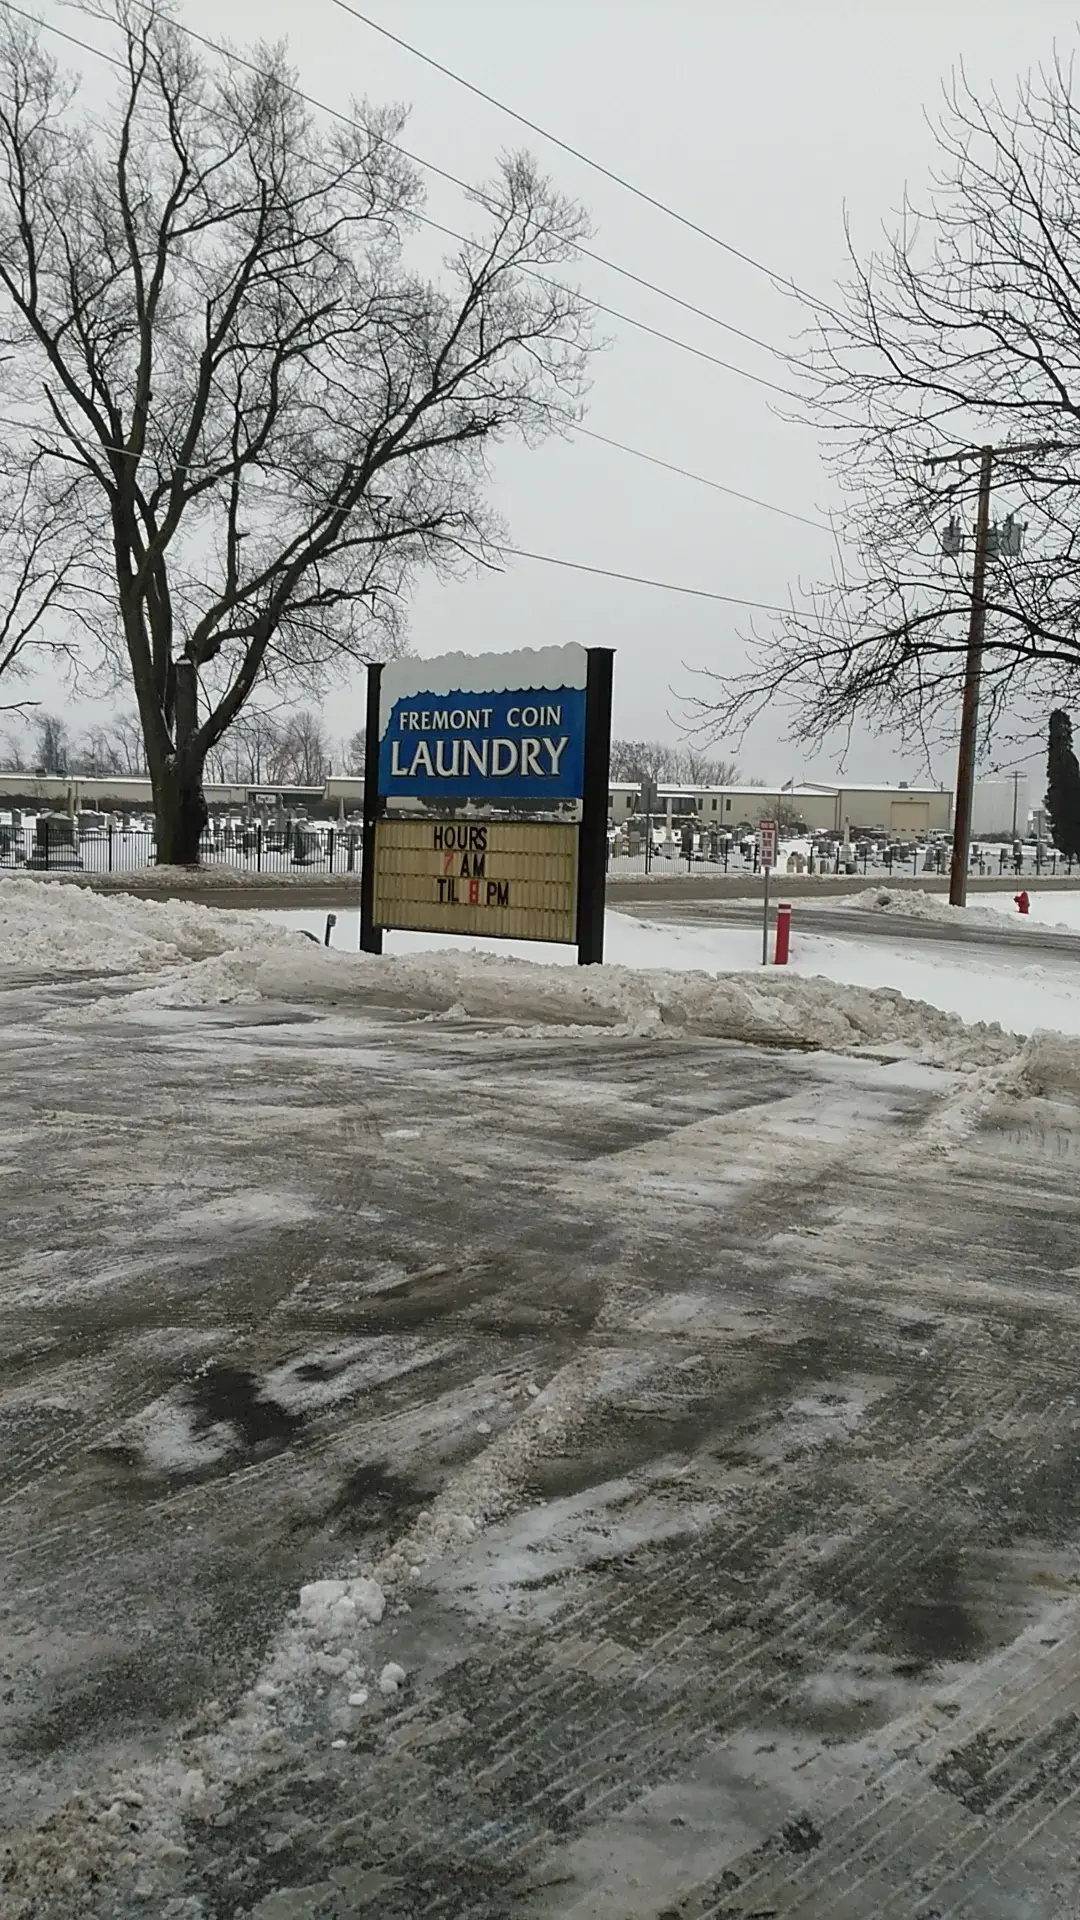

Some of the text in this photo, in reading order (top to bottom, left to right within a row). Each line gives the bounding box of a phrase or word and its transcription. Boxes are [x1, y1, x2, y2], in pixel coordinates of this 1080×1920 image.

[399, 705, 562, 731] FREMONT COIN
[391, 736, 569, 777] LAUNDRY
[433, 826, 488, 851] HOURS
[443, 851, 486, 877] 7 AM
[437, 878, 510, 905] TIL 8 PM
